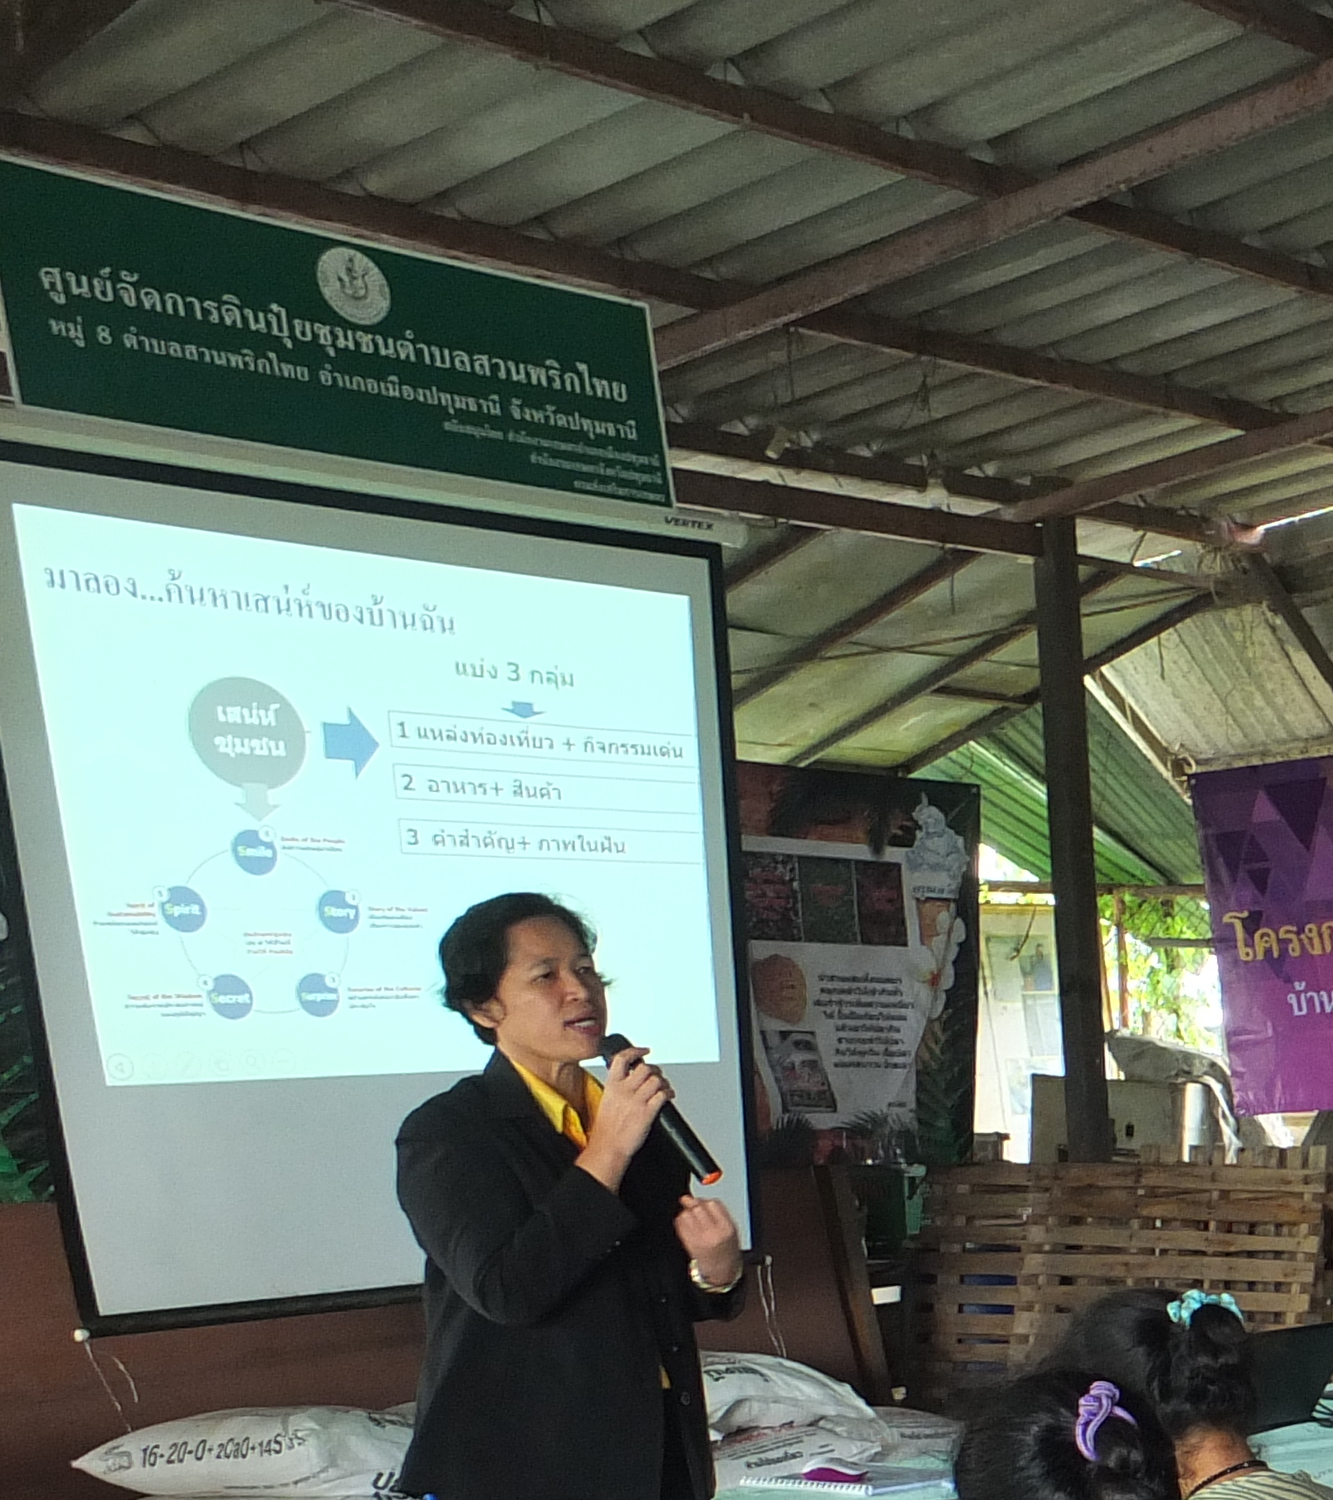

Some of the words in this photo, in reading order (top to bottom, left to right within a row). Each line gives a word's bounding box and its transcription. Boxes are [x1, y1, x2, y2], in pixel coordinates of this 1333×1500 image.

[48, 316, 86, 348] หมู่
[97, 325, 113, 345] 8
[123, 326, 309, 381] ตำบลสวนพริกไทย
[320, 363, 501, 416] อำเภอเมืองปทุมธานี
[510, 397, 638, 442] จังหวัดปทุมธานี
[665, 515, 715, 531] VERTEX
[455, 658, 498, 680] แบ่ง
[506, 662, 520, 682] 3
[530, 665, 574, 690] กลุ่ม
[213, 733, 286, 759] ชุมชน
[397, 721, 409, 739] 1
[416, 724, 554, 750] แหล่งท่องเที่ยว
[583, 737, 683, 759] กิจกรรมเด่น
[401, 774, 415, 792] 2
[512, 779, 562, 800] สินค้า
[407, 829, 419, 846] 3
